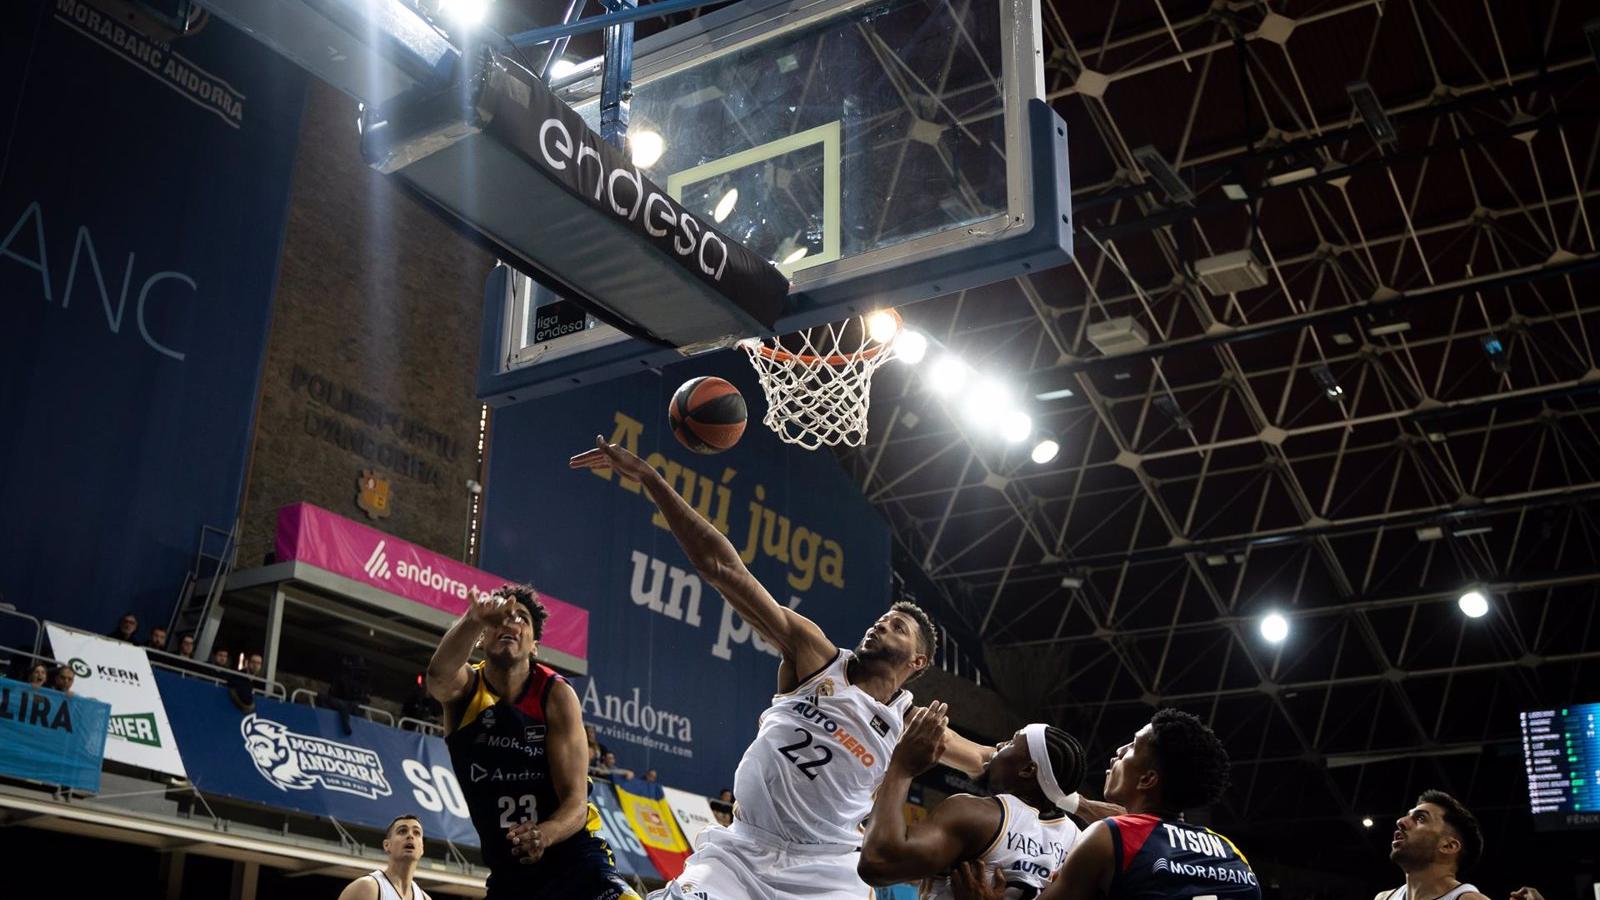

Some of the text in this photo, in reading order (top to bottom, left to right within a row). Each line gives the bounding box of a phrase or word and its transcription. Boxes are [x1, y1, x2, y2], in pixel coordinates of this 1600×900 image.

[56, 0, 244, 121] MORABANC ANDORRA
[538, 118, 728, 281] endesa
[536, 320, 583, 341] endesa
[537, 315, 559, 329] liga
[740, 484, 845, 592] juga
[396, 558, 468, 600] andorra
[630, 550, 703, 628] un
[97, 664, 140, 682] KERN
[581, 675, 693, 743] Andorra
[289, 736, 377, 768] MORABANC
[299, 751, 386, 789] ANDORRA
[777, 727, 833, 780] 22
[497, 794, 539, 829] 23
[1163, 823, 1228, 859] TYSON
[1170, 861, 1258, 887] MORABANC
